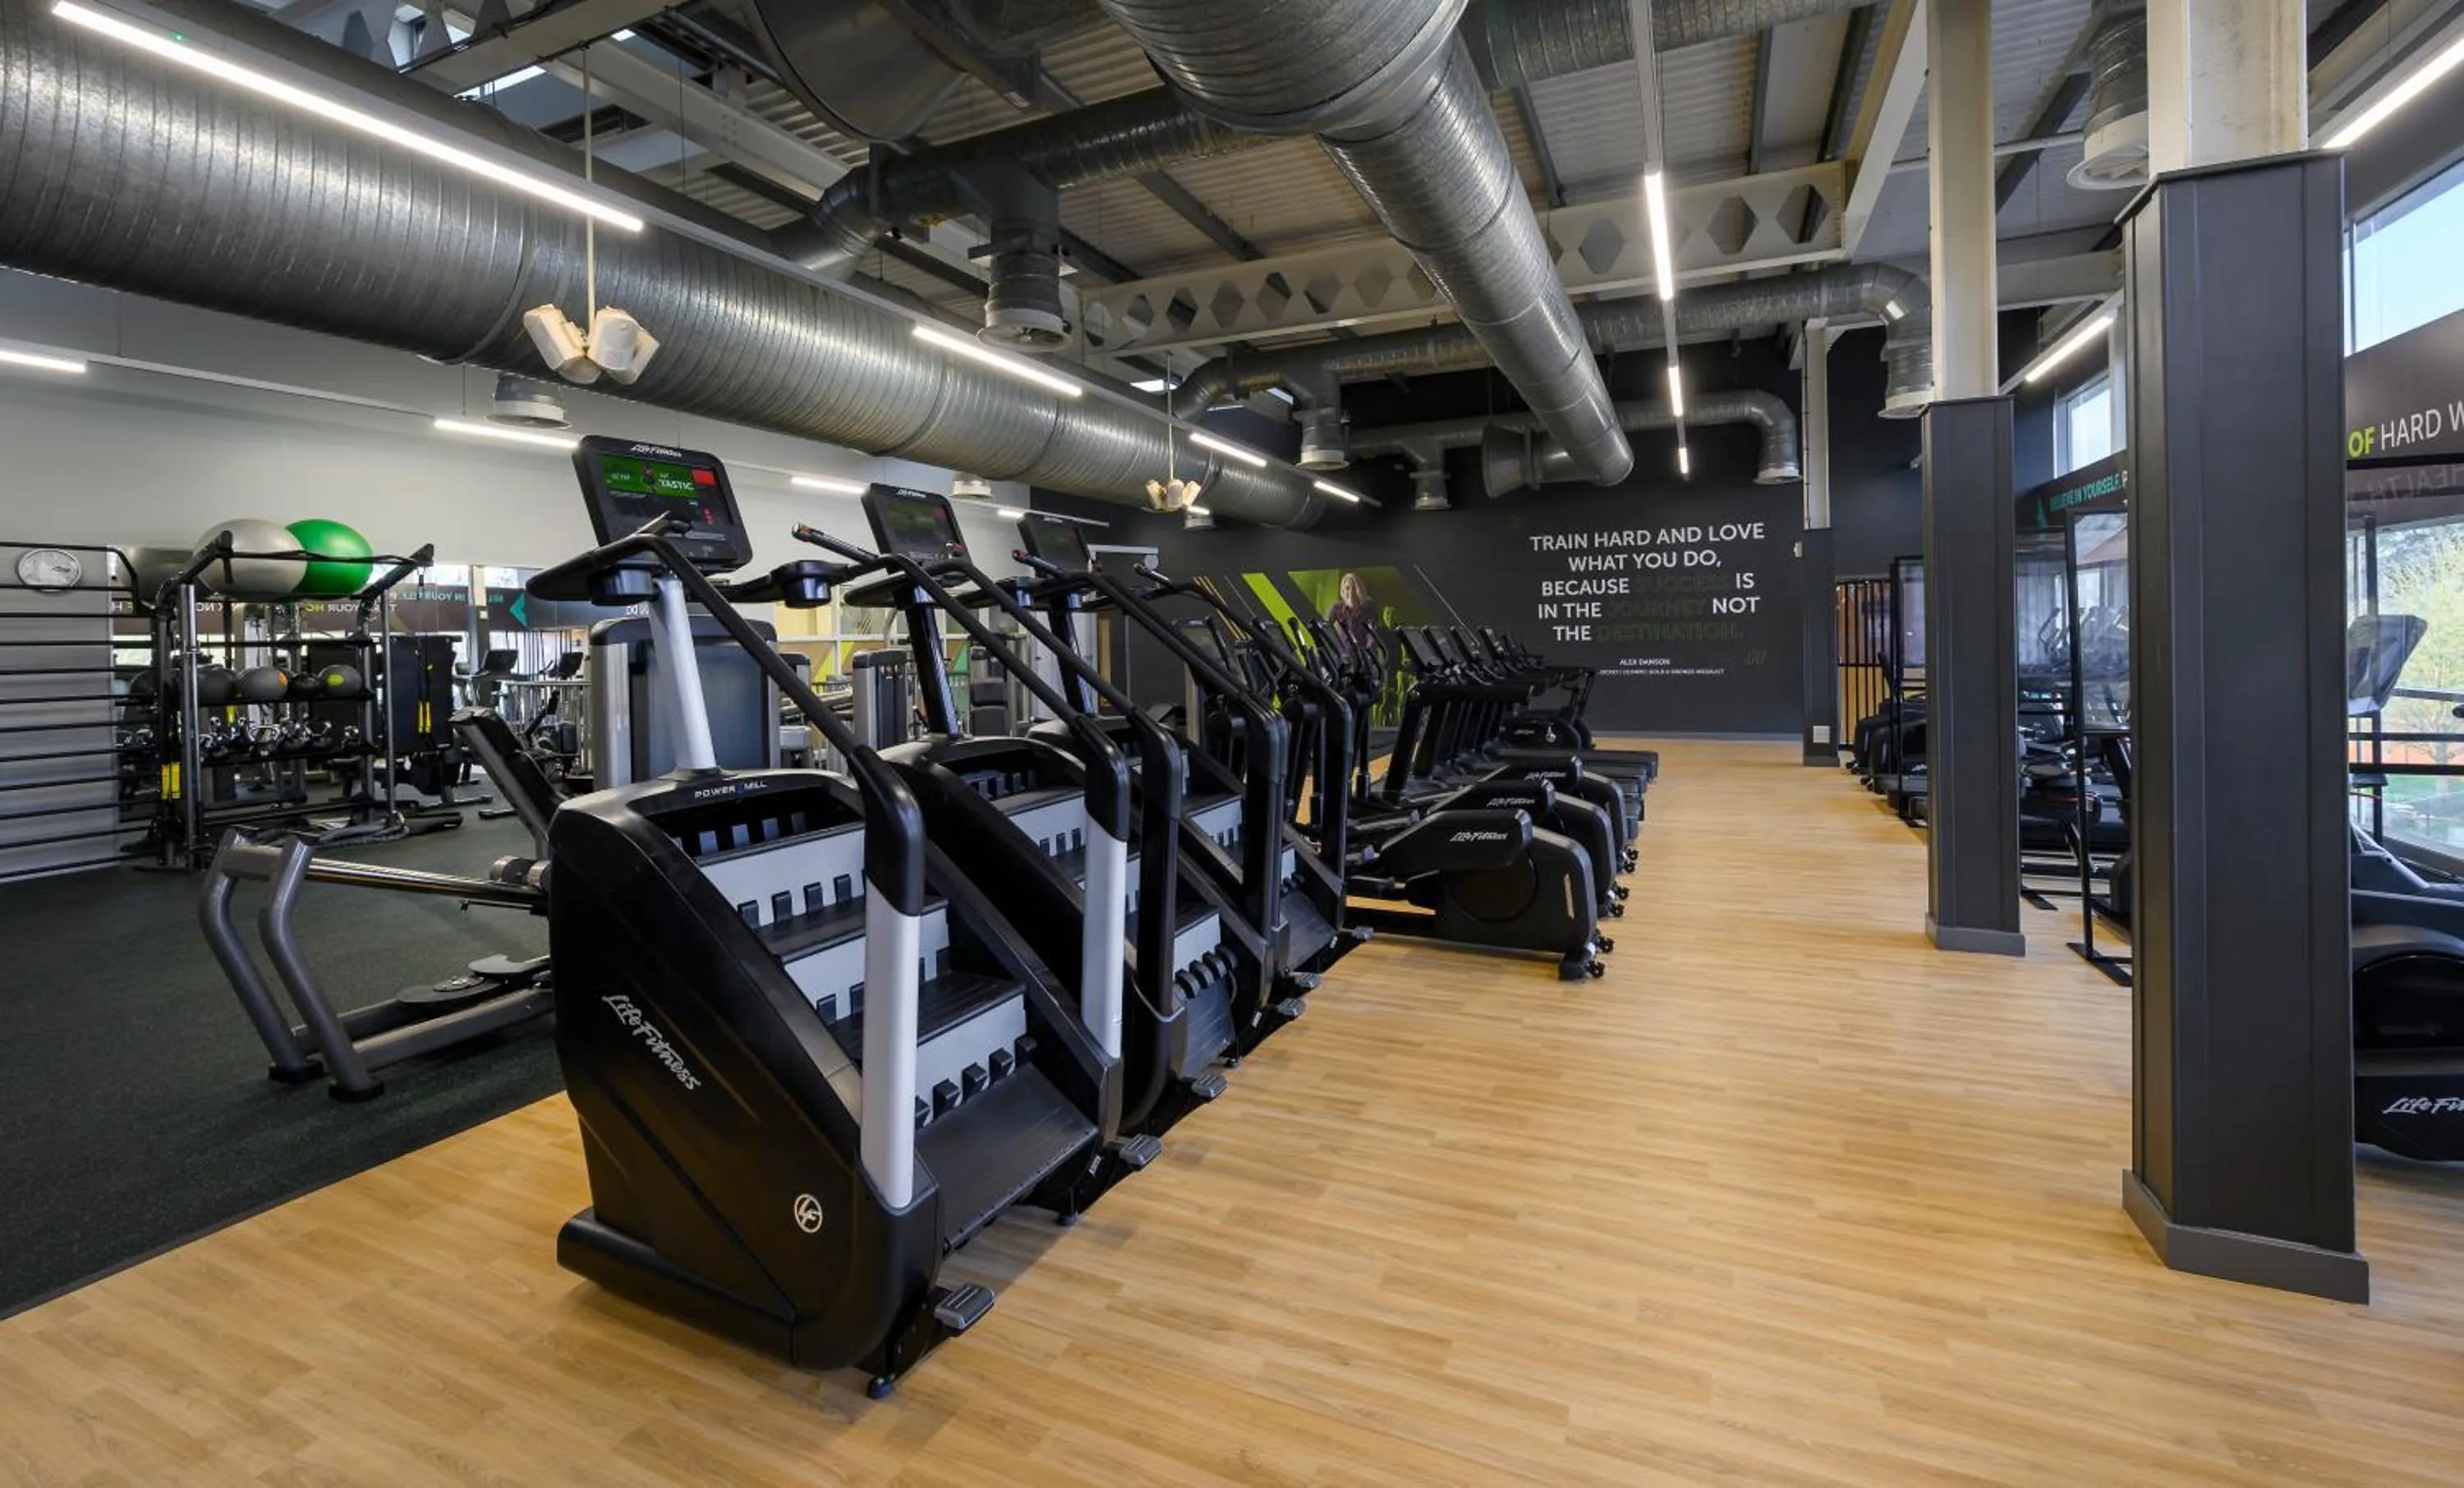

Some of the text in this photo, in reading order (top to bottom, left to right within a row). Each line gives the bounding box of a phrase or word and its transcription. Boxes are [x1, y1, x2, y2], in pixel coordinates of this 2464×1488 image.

[2348, 426, 2376, 458] OF
[2381, 408, 2443, 451] HARD
[1529, 522, 1765, 551] TRAIN HARD AND LOVE
[1568, 549, 1722, 572] WHAT YOU DO,
[1542, 577, 1630, 596] BECAUSE
[1735, 572, 1755, 589] IS
[1538, 604, 1558, 620] IN
[1562, 602, 1602, 618] THE
[1712, 596, 1760, 614] NOT
[1552, 625, 1592, 641] THE
[694, 781, 769, 799] POWER MILL
